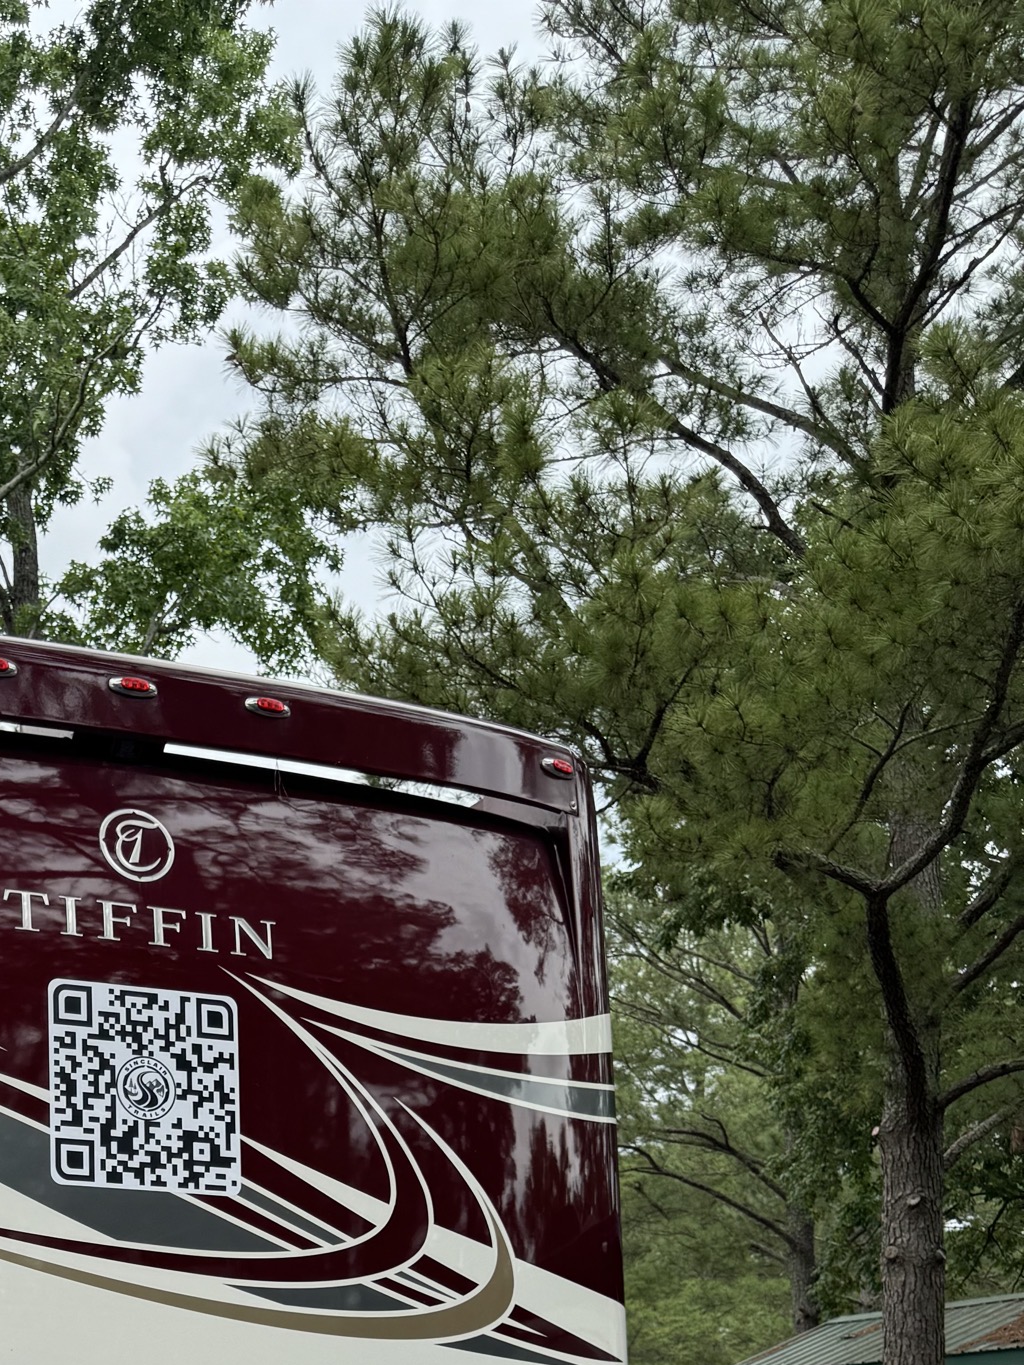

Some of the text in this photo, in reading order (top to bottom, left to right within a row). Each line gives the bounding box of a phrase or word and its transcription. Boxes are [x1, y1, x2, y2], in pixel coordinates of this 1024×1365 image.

[3, 888, 277, 960] TIFFIN
[124, 1059, 168, 1076] SINCLAIR
[127, 1104, 166, 1118] TRAILS
